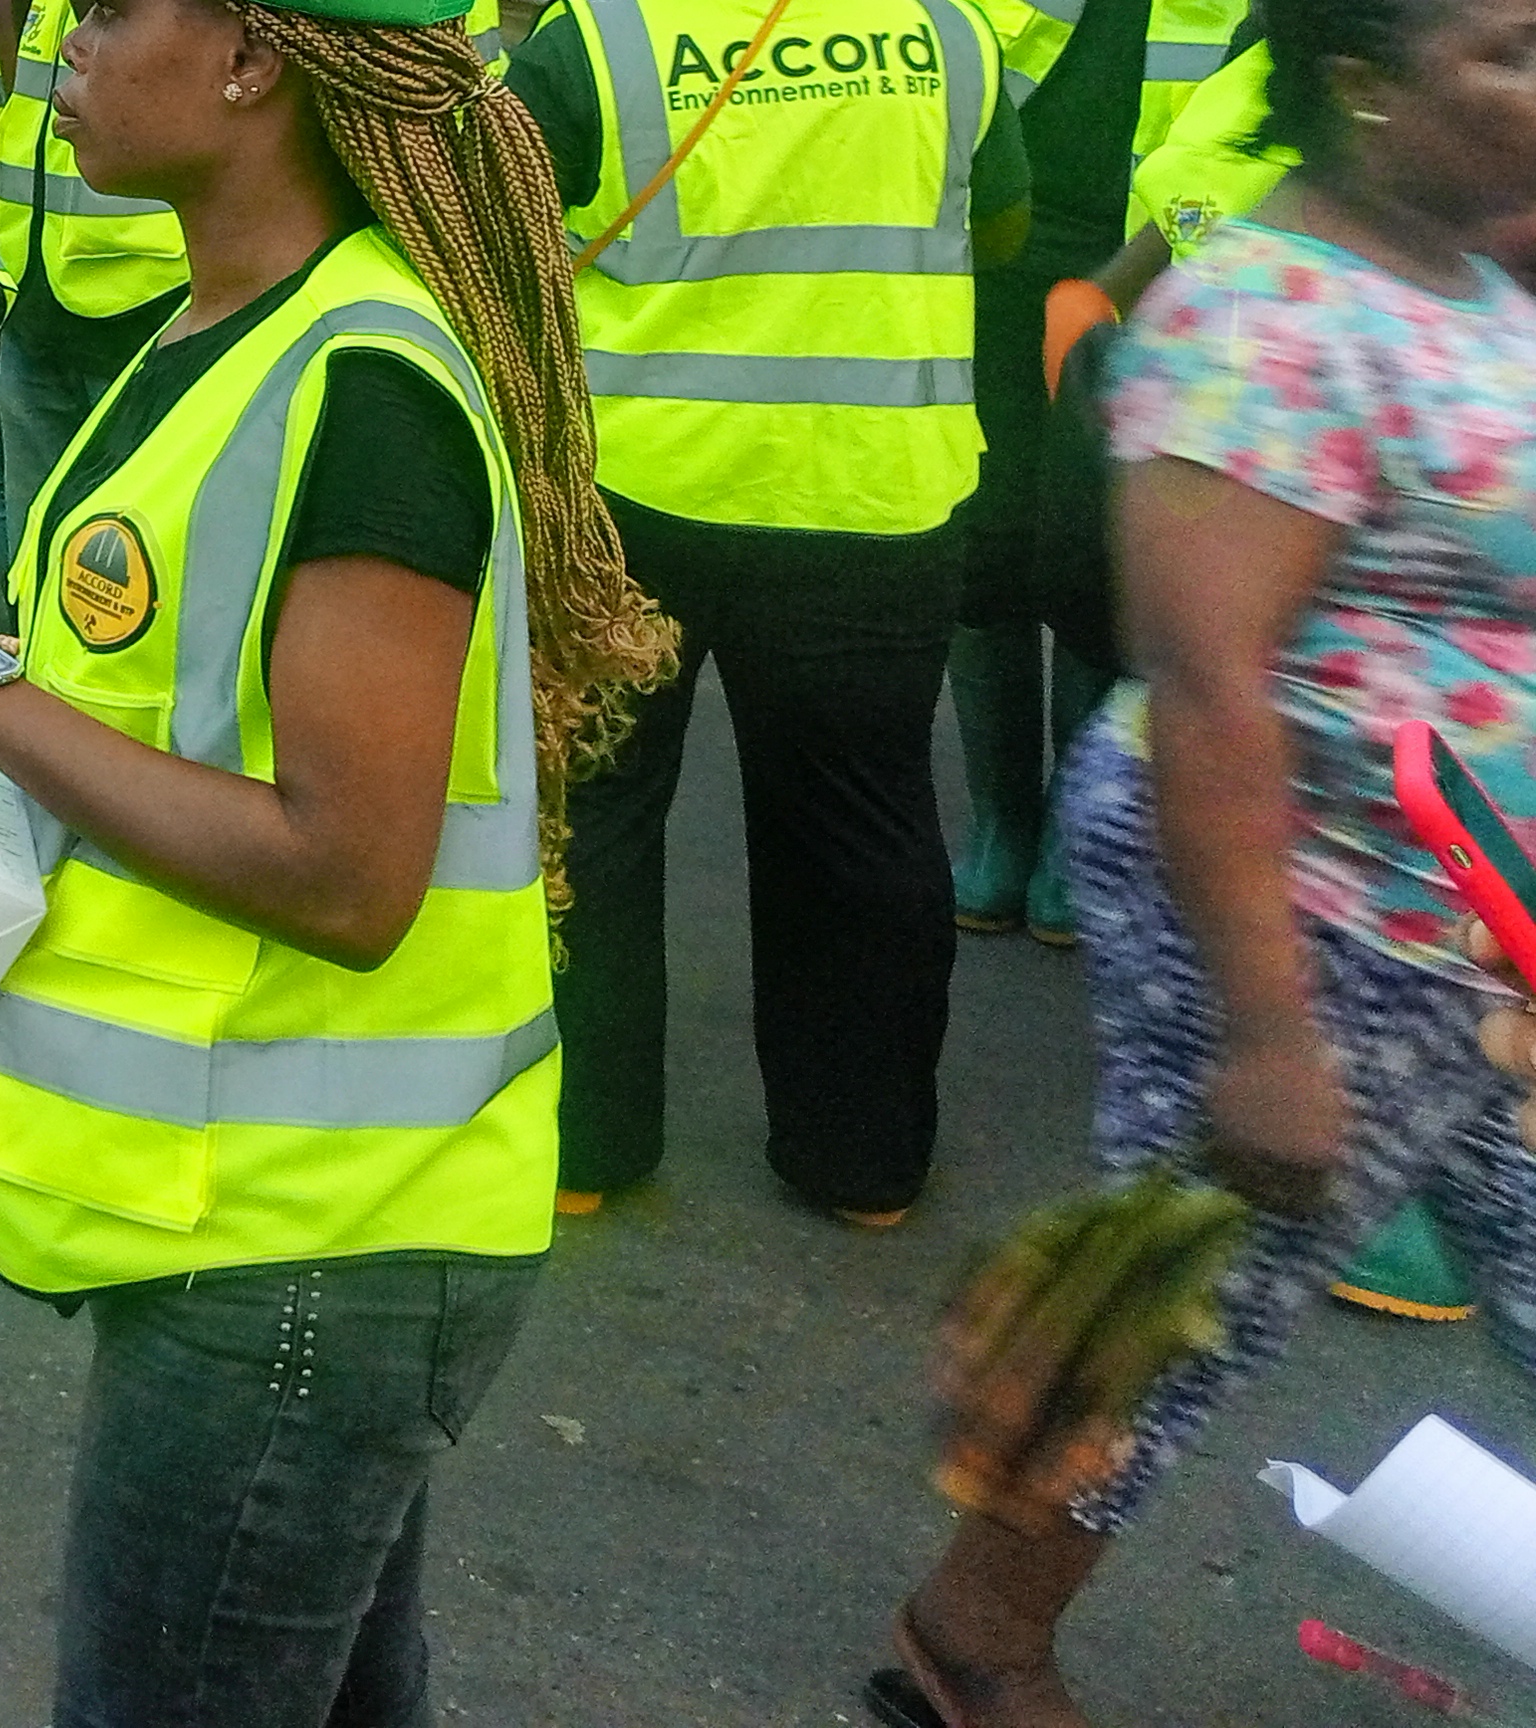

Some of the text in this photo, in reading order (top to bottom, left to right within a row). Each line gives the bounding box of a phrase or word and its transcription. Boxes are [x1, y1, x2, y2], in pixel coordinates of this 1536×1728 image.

[665, 21, 940, 87] Accord
[667, 75, 941, 111] Envonnement & BTP
[77, 569, 124, 600] ACCORD
